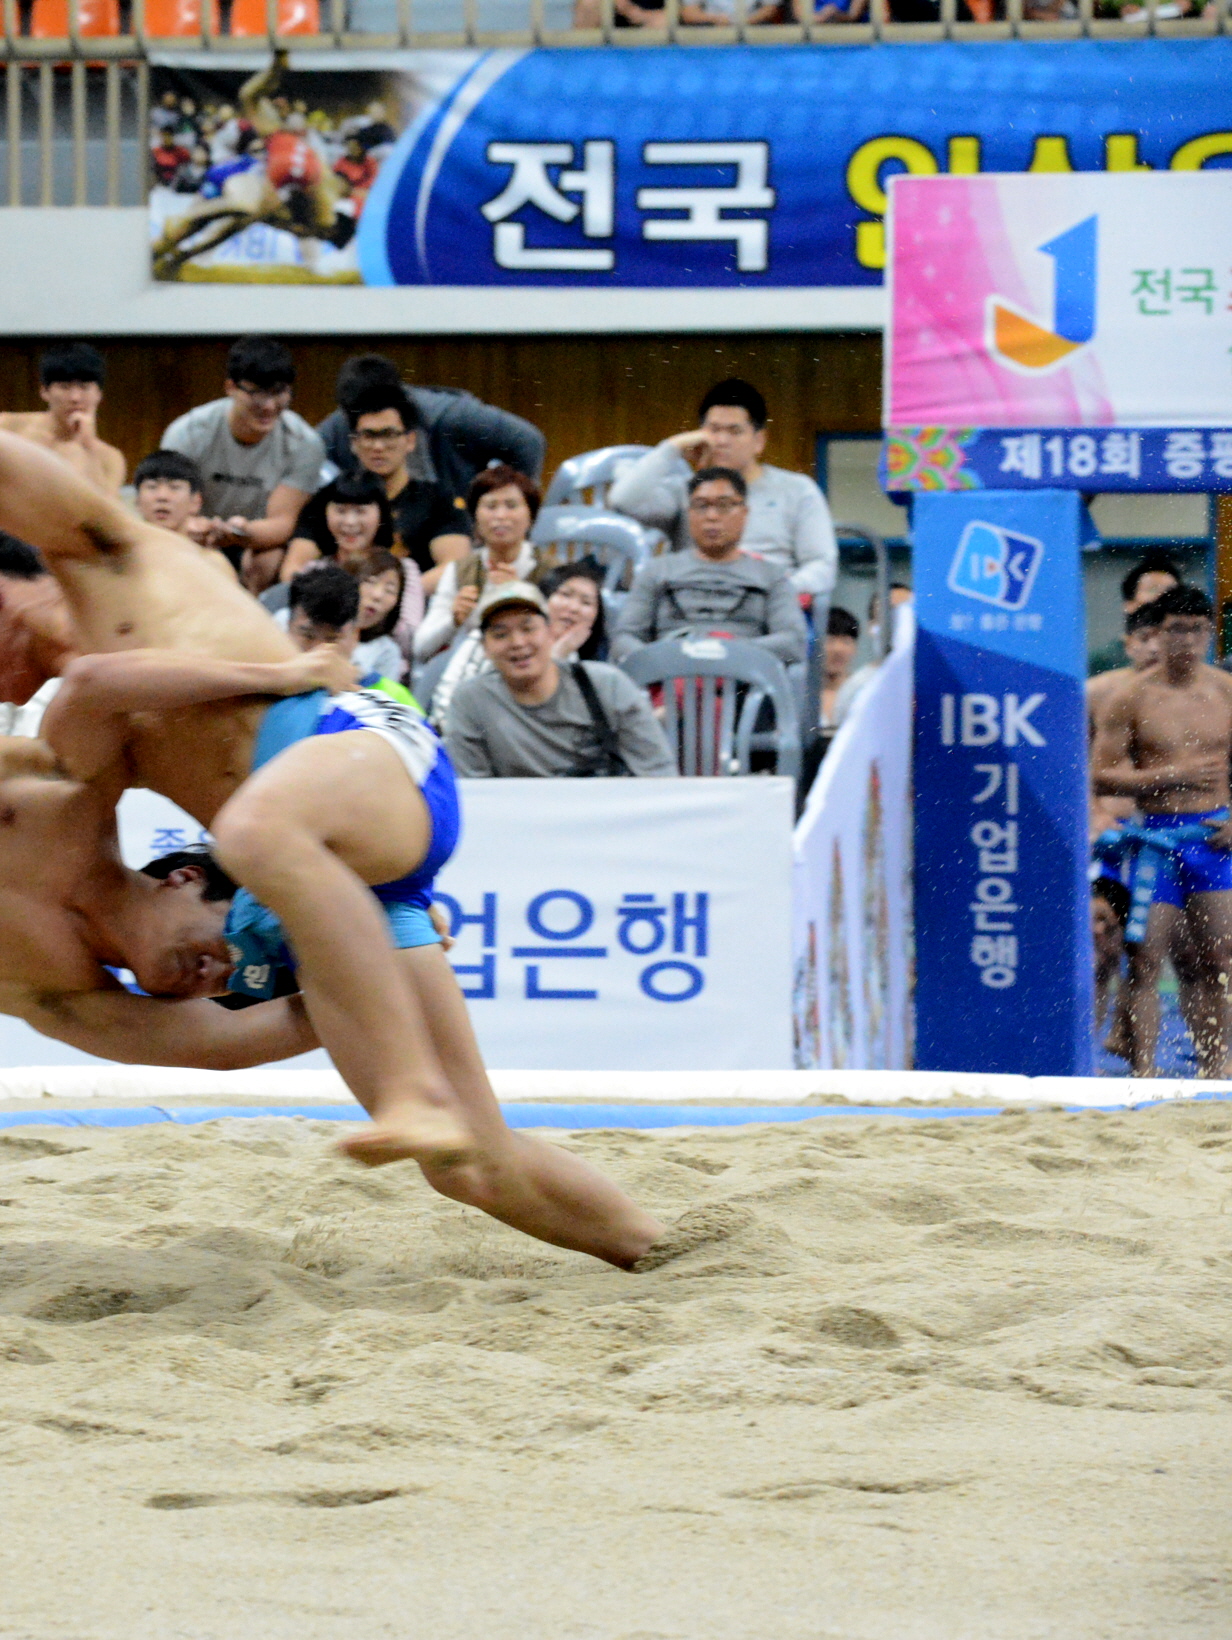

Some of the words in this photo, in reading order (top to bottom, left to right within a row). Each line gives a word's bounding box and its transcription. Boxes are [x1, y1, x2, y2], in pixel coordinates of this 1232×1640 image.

[481, 140, 775, 271] 전국
[1131, 268, 1217, 316] 전국
[999, 432, 1141, 478] 제18회
[940, 693, 1047, 747] IBK
[971, 763, 1018, 988] 기업은행
